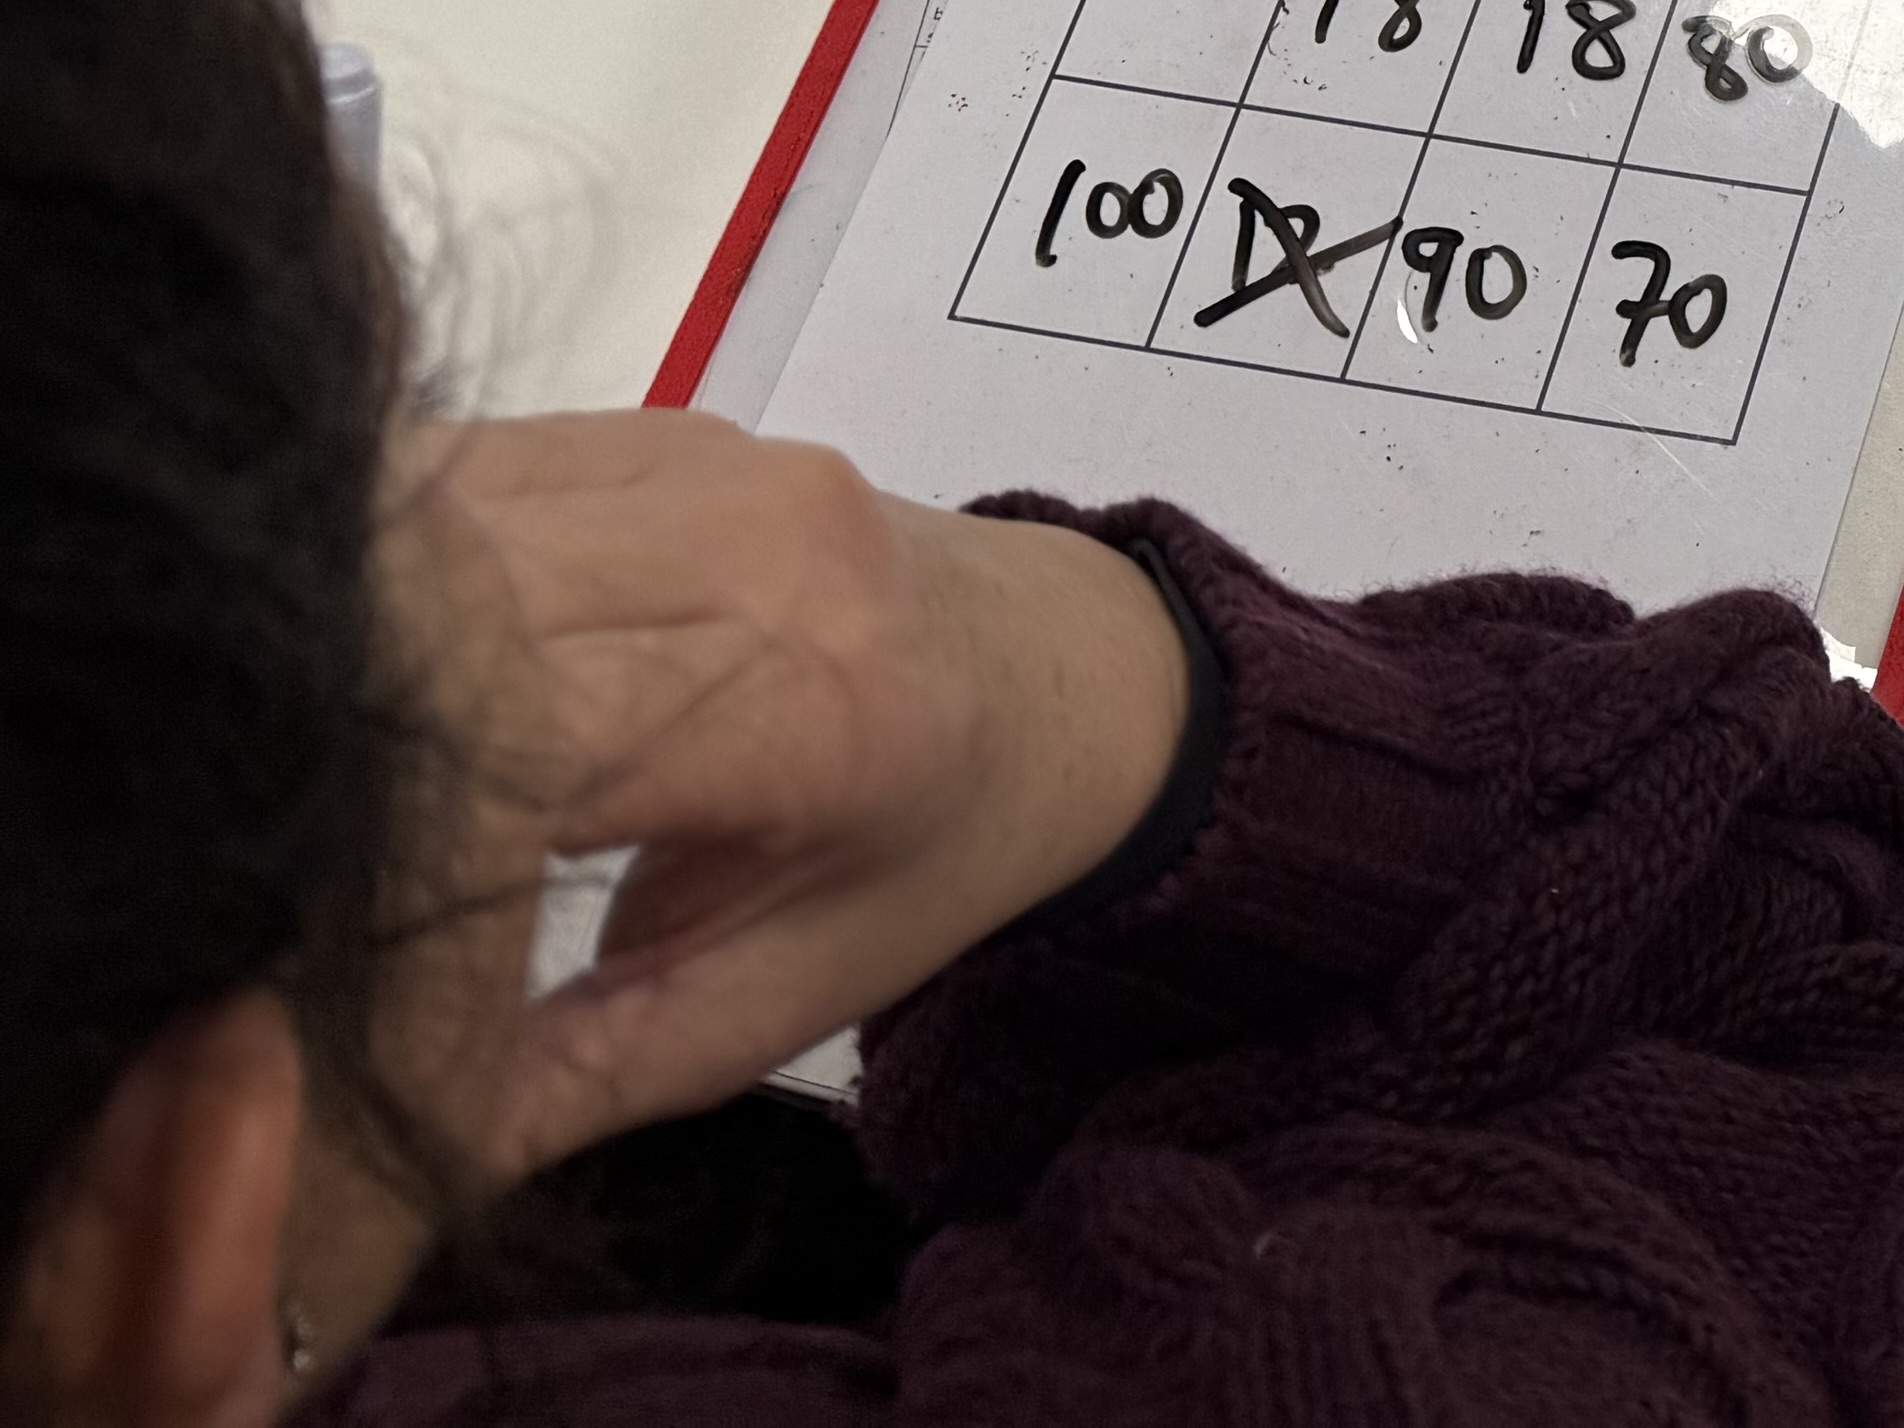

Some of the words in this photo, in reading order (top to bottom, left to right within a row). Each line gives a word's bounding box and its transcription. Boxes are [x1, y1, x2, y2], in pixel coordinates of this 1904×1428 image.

[1681, 13, 1812, 103] 80
[1034, 159, 1184, 268] 100
[1402, 226, 1528, 333] 90
[1612, 240, 1729, 367] 70
